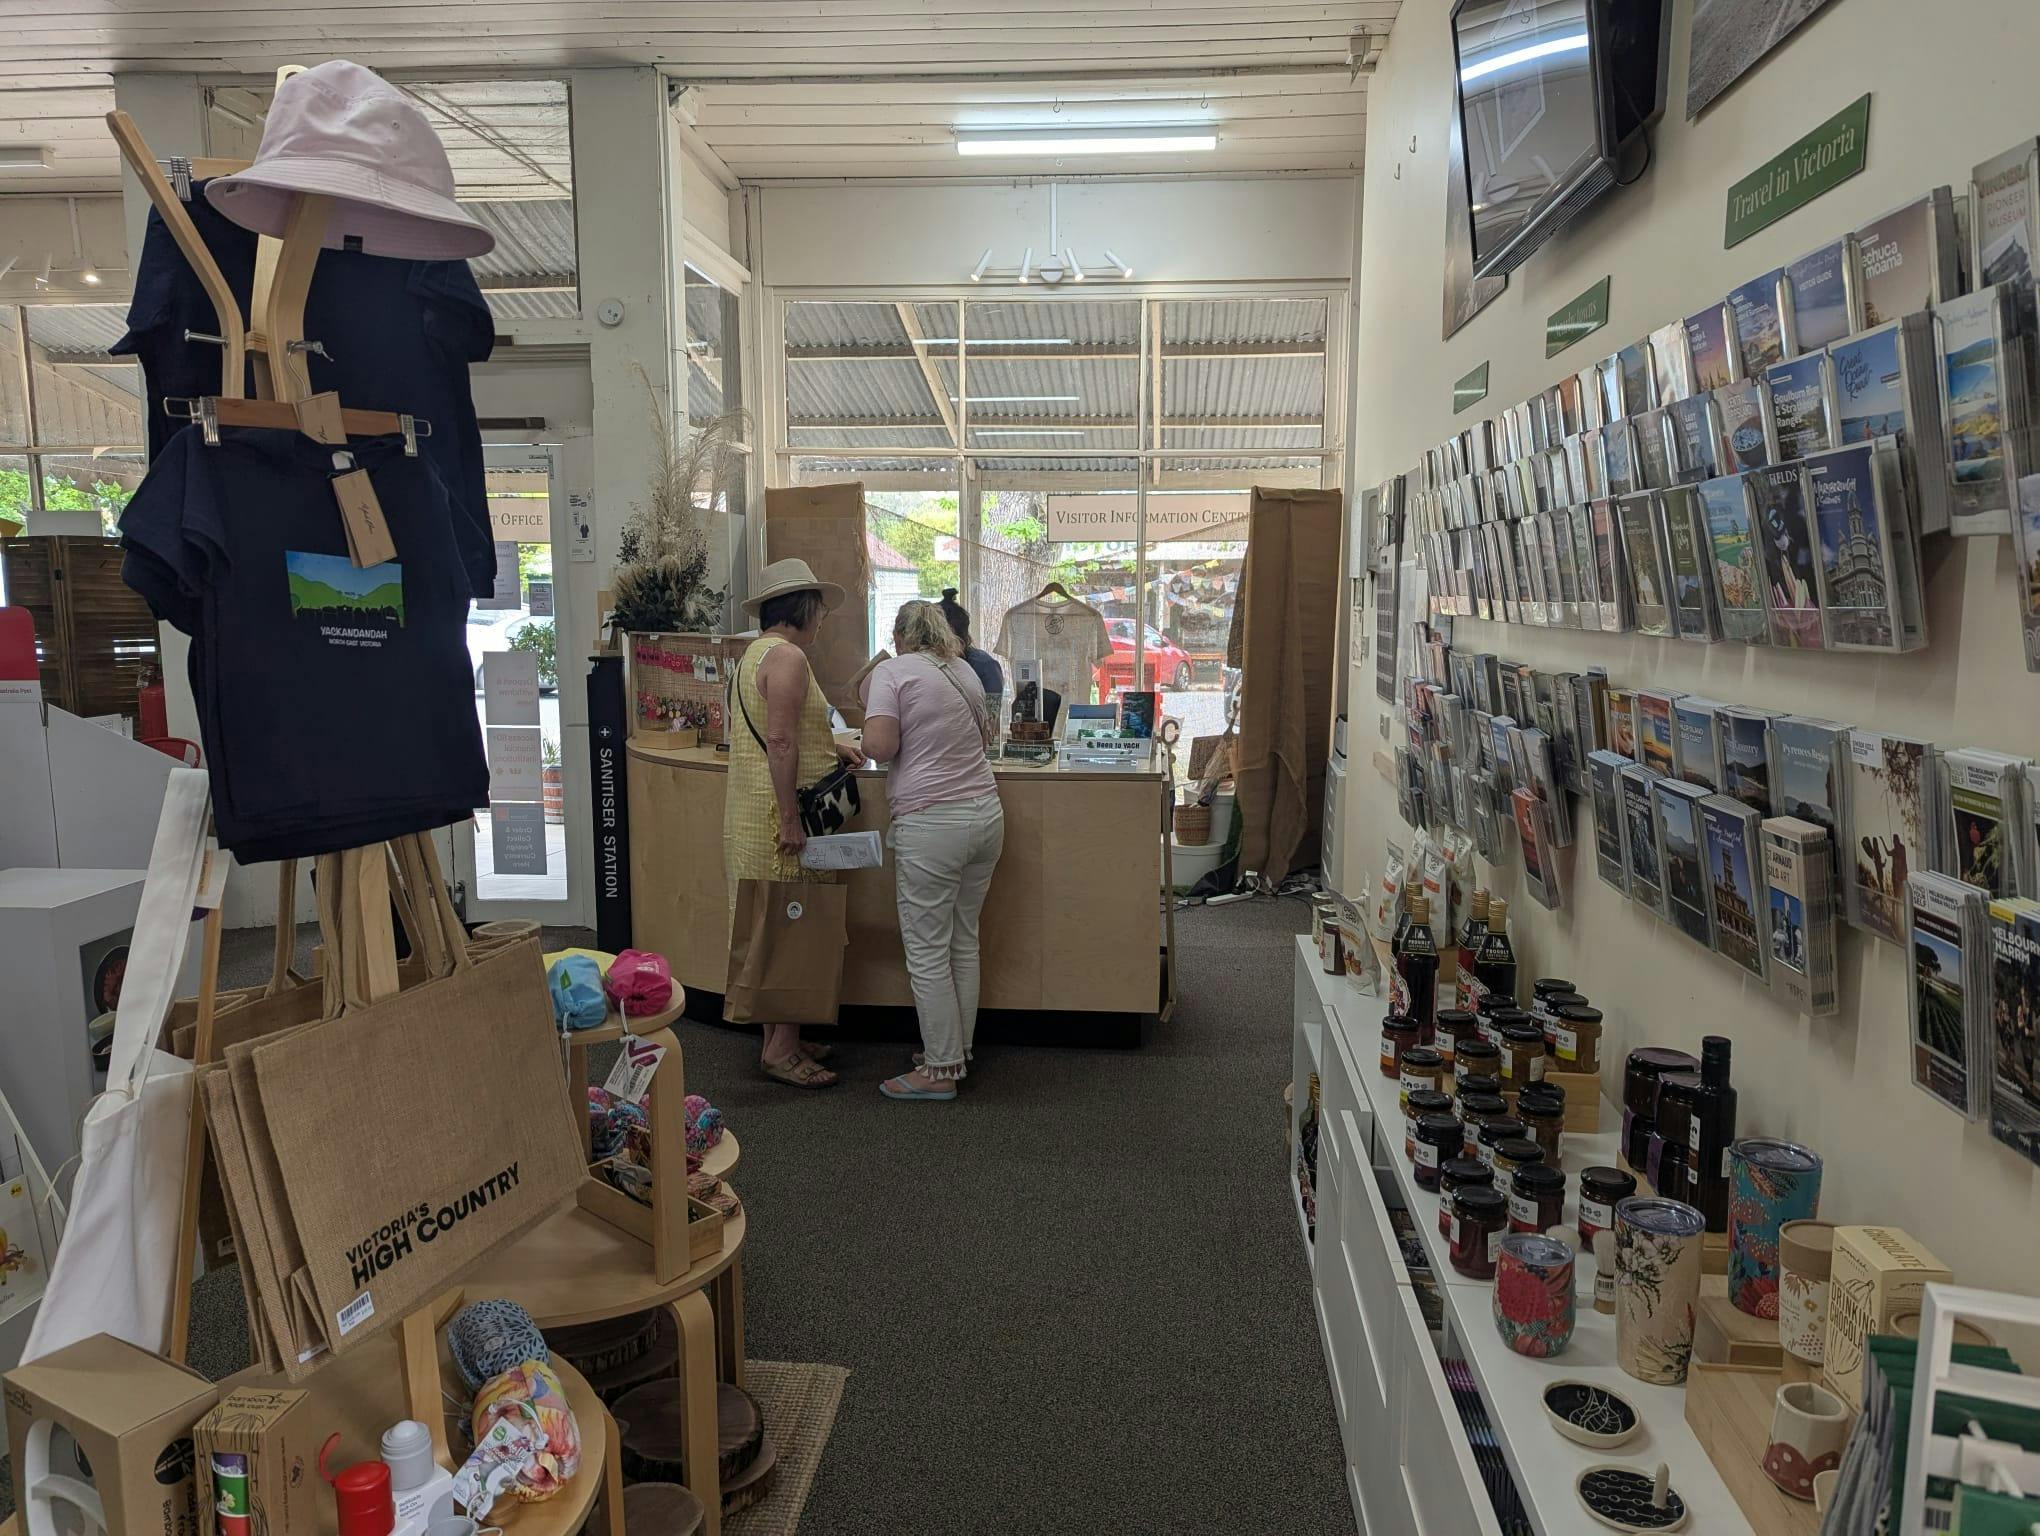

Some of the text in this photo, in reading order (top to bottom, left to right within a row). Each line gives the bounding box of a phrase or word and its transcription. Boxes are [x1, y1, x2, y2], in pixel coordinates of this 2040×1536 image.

[1732, 123, 1855, 223] Travel in Victoria
[1862, 241, 1898, 267] echuca
[1865, 253, 1903, 280] moama
[1773, 386, 1806, 404] Goulburn
[1768, 468, 1798, 487] FIELDS
[501, 512, 544, 526] OFFICE
[1056, 510, 1106, 524] VISITOR
[320, 626, 388, 639] YACKANDANDAH
[1782, 742, 1811, 759] Pyrenees
[600, 747, 618, 899] SANITISER STATION
[345, 1202, 431, 1264] VICTORIA'S
[351, 1161, 520, 1290] HIGH COUNTRY
[1862, 1227, 1928, 1269] CHOCOLATE
[1830, 1281, 1877, 1336] DRINKING
[1829, 1301, 1864, 1353] CHOCOLA
